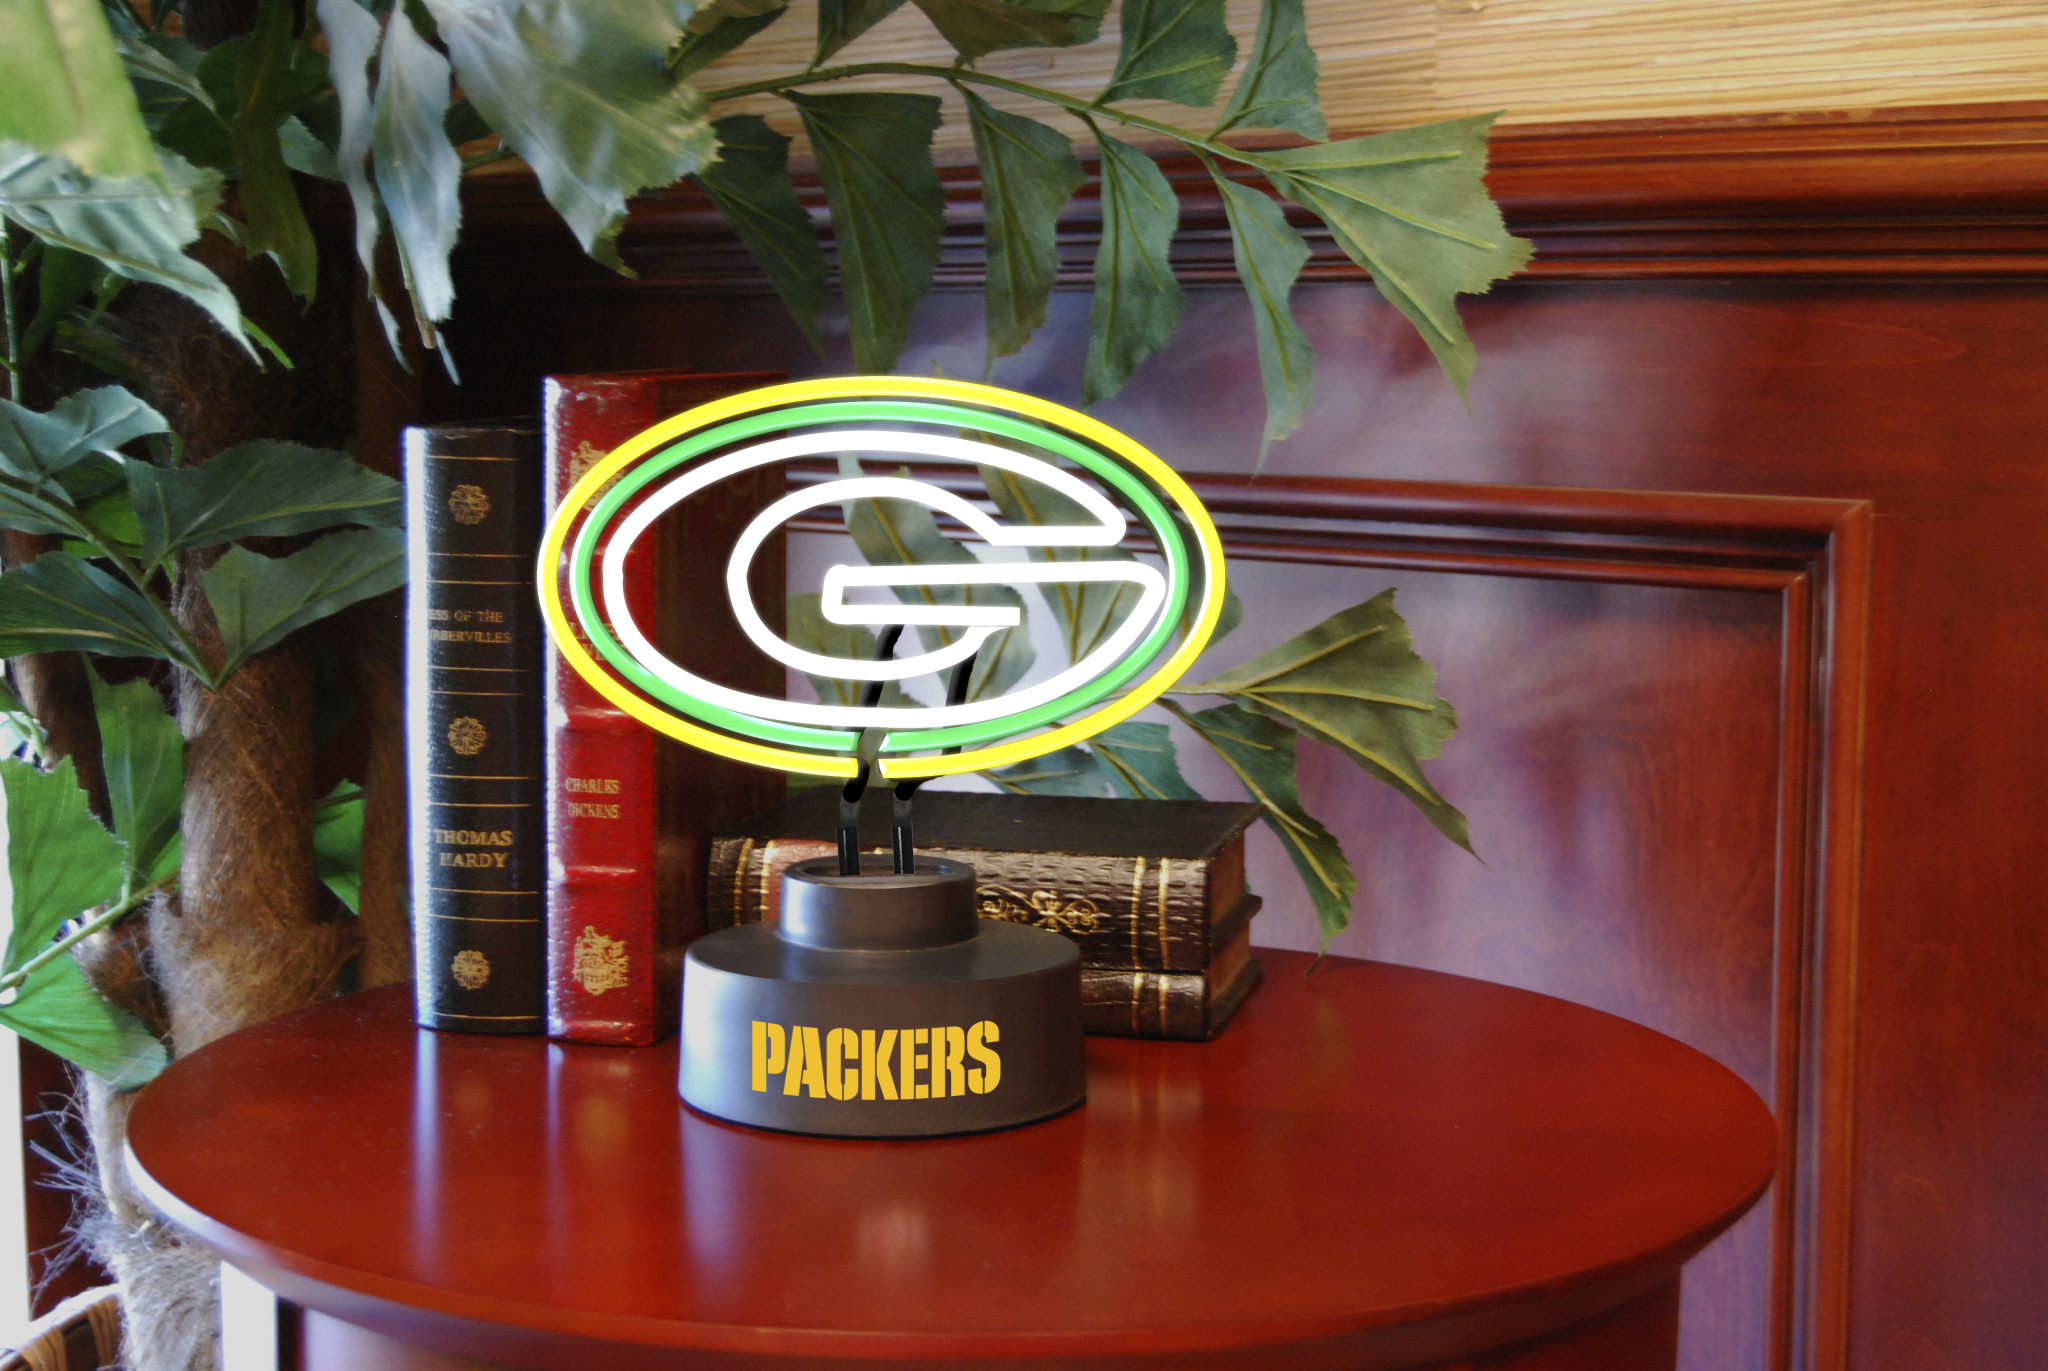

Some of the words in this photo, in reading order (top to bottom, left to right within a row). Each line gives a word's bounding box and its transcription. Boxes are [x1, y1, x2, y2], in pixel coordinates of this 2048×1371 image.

[428, 608, 449, 621] ESS
[454, 609, 472, 622] OF
[476, 610, 505, 623] THE
[565, 777, 620, 794] CHARLES
[567, 802, 620, 819] DICKENS
[433, 829, 514, 846] THOMAS
[440, 852, 508, 868] HARDY
[751, 1020, 1002, 1101] PACKERS
